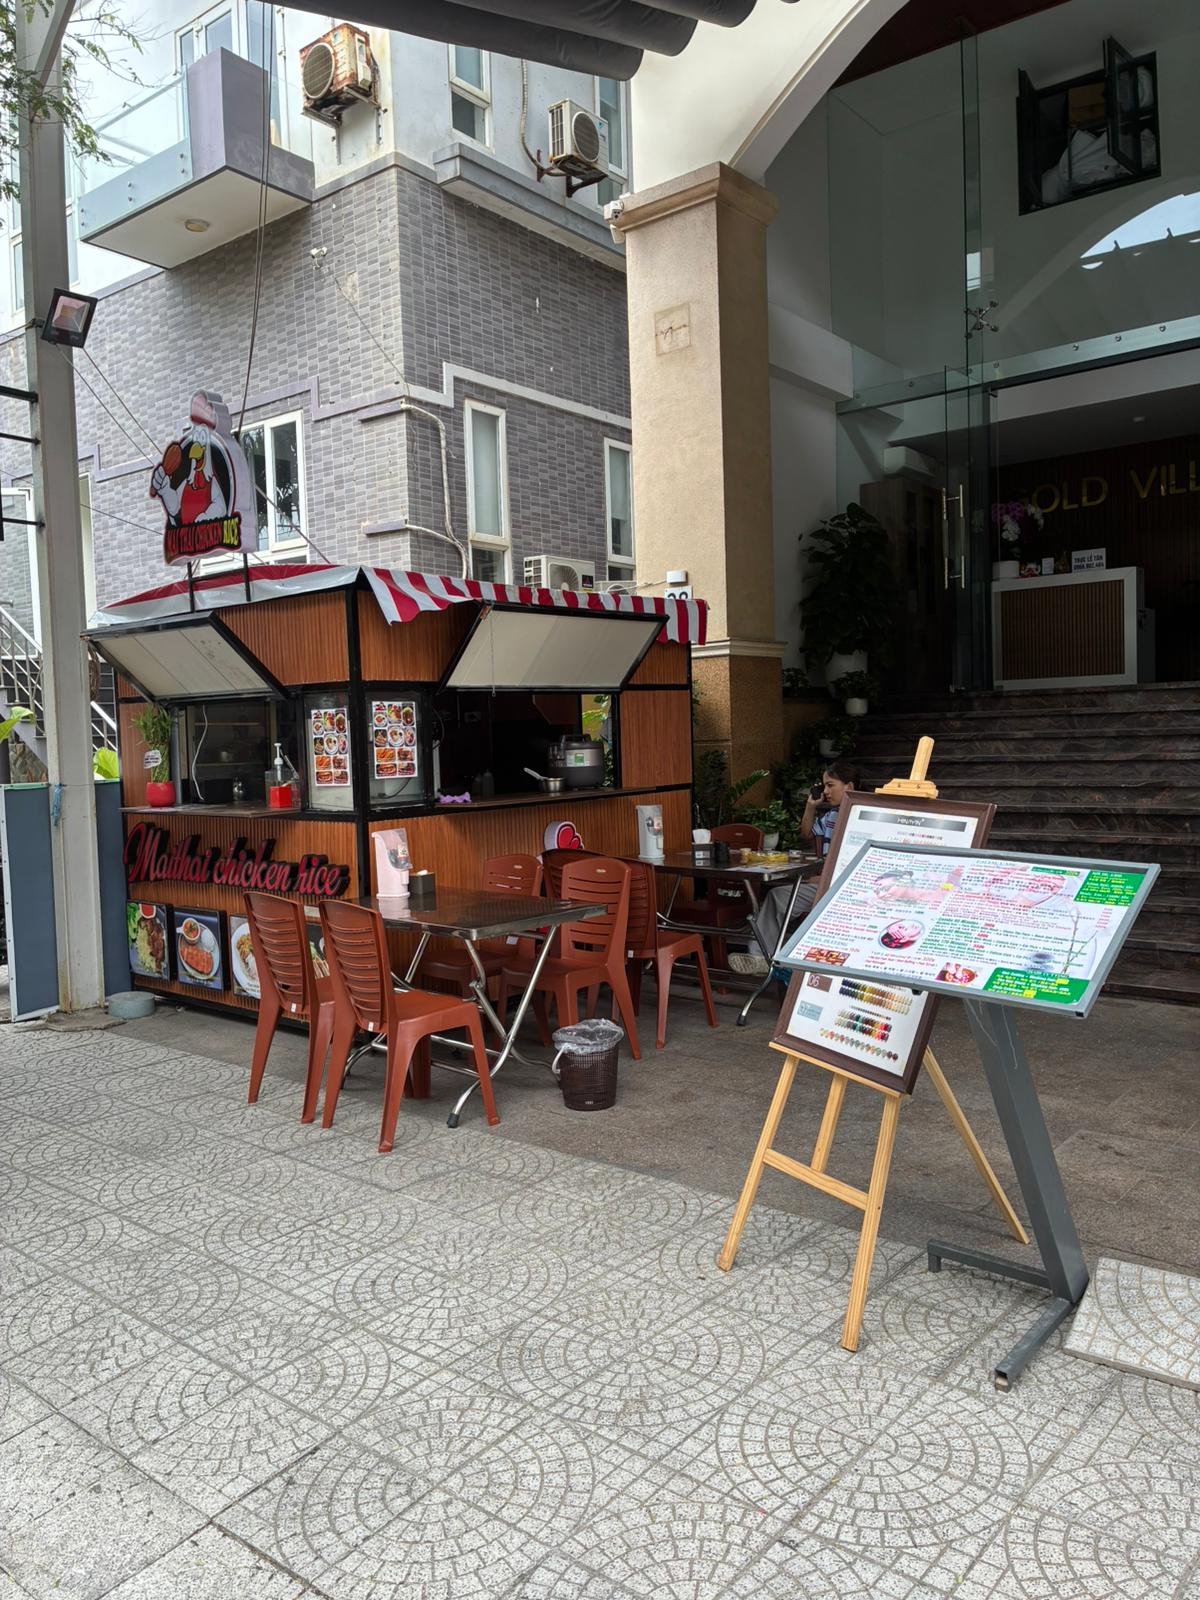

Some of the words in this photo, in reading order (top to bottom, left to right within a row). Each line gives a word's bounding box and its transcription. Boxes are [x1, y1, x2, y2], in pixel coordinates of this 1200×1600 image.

[223, 517, 239, 546] RICE
[123, 821, 211, 884] Maithai
[213, 839, 293, 892] chicken
[292, 855, 344, 897] rice
